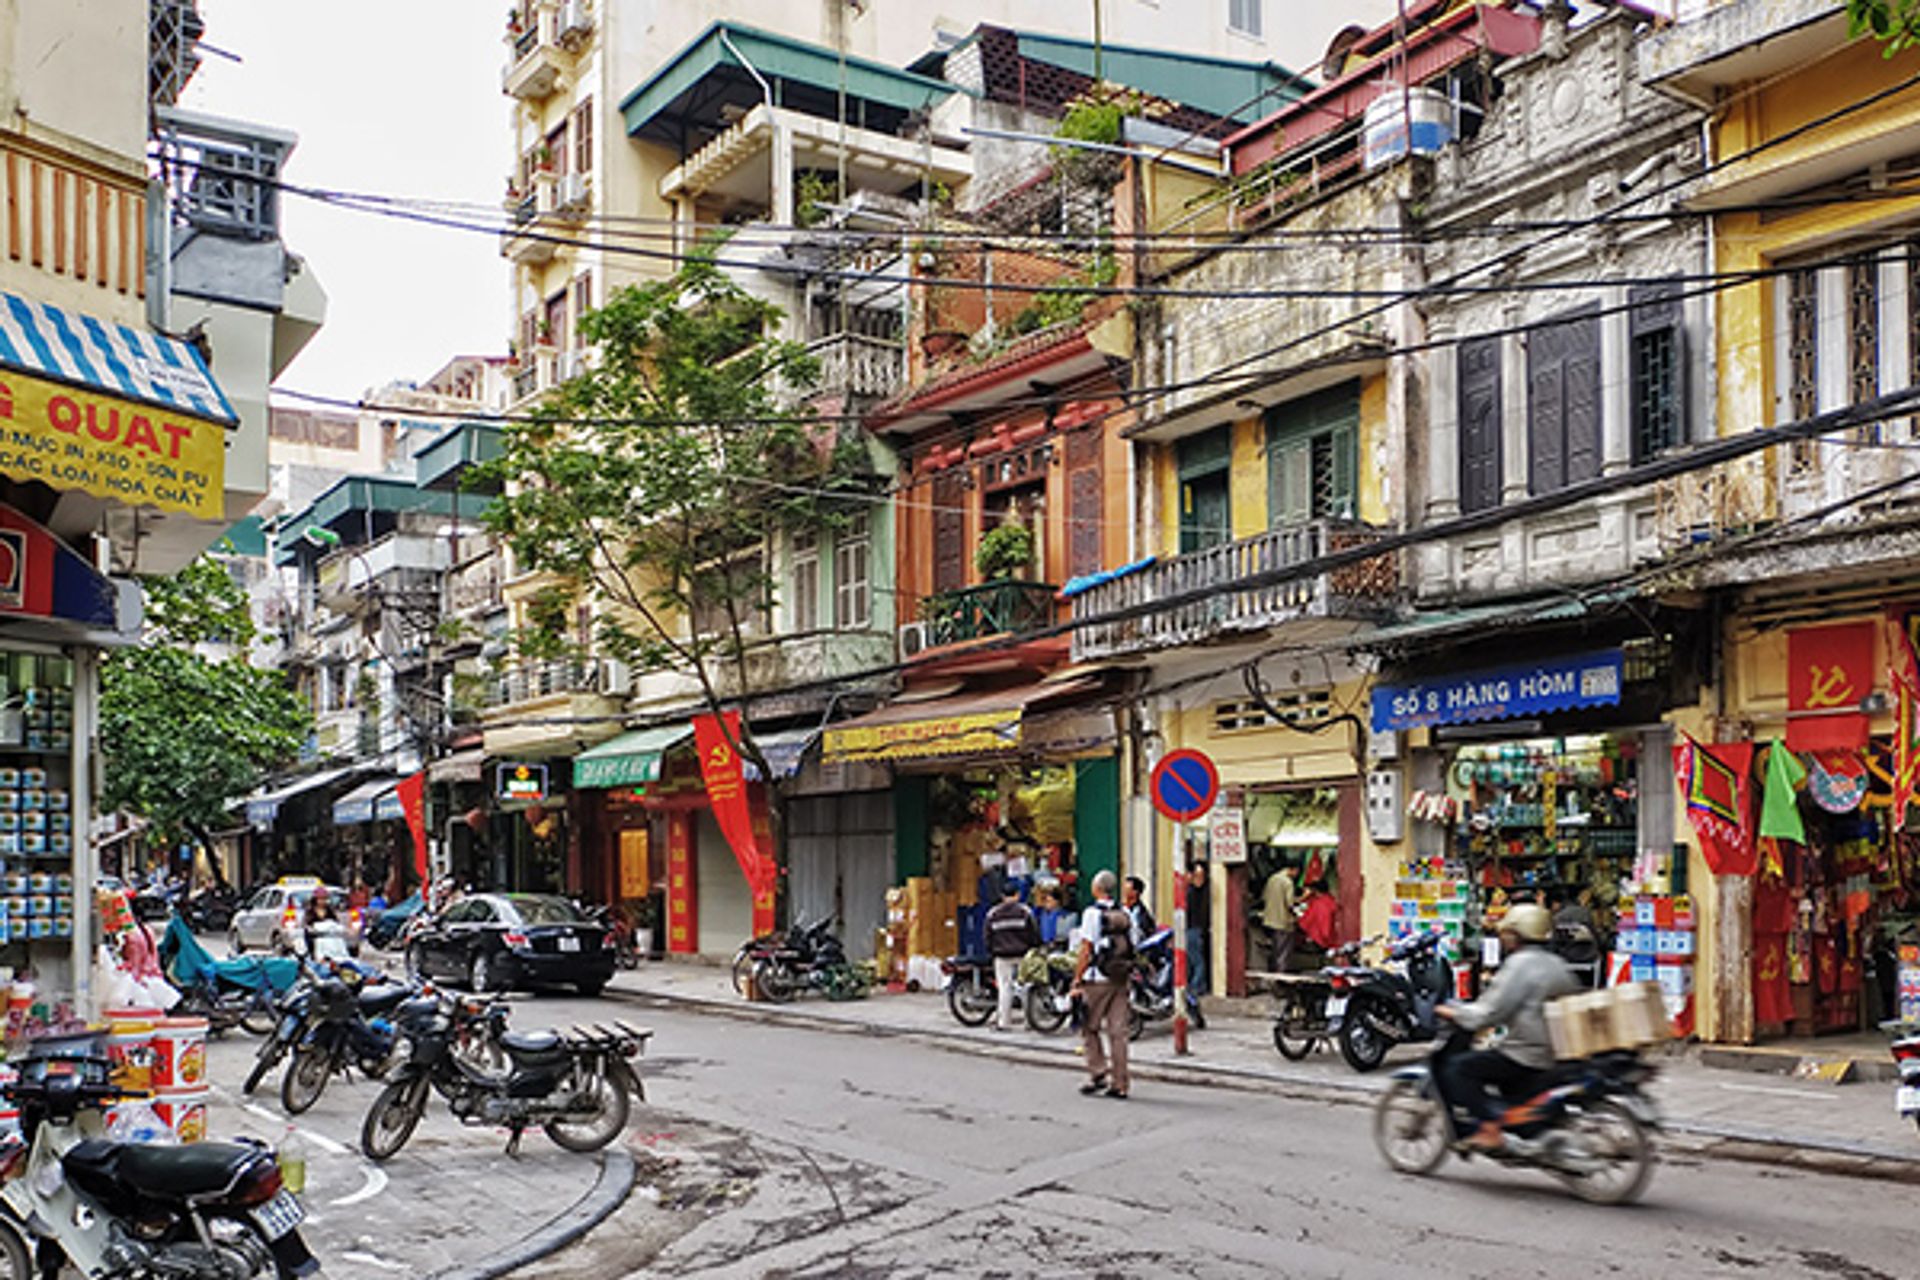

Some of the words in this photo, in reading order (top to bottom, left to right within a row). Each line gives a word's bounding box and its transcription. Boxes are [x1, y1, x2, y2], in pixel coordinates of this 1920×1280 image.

[48, 395, 191, 459] QUẠT
[1392, 684, 1422, 715] SỐ
[1427, 690, 1438, 712] 8
[1446, 681, 1511, 708] HÀNG
[1520, 669, 1574, 698] HÒM
